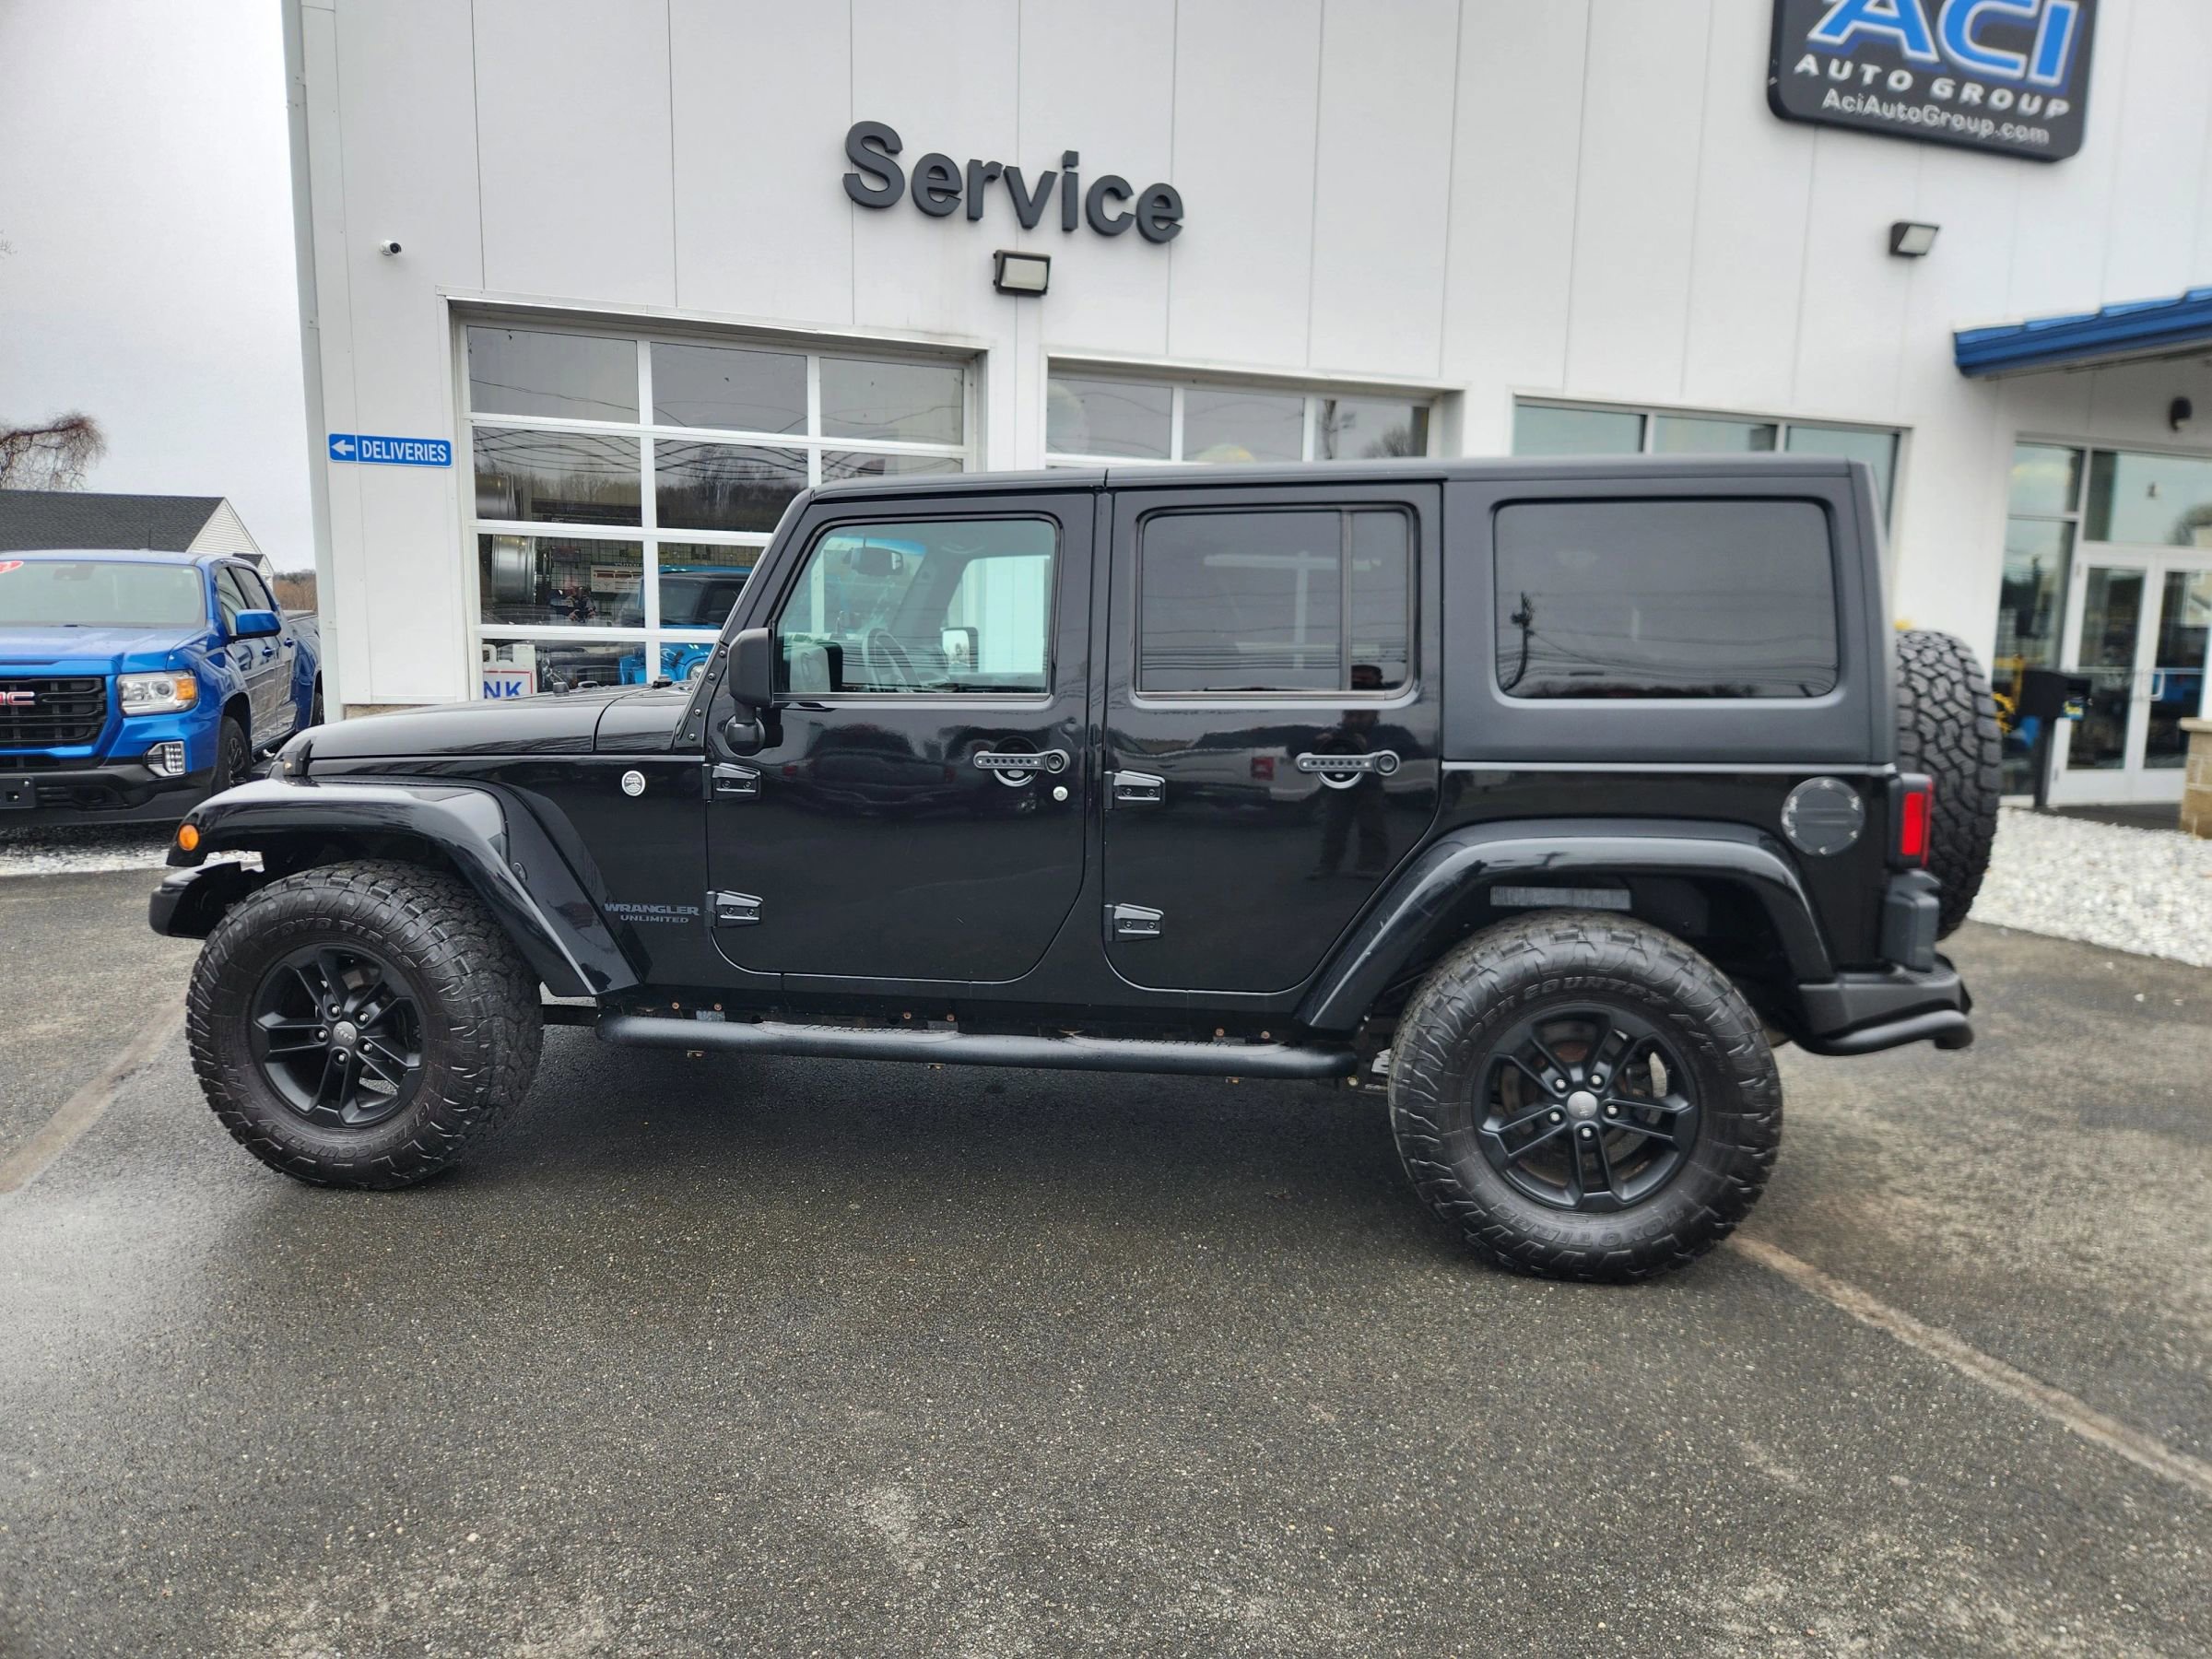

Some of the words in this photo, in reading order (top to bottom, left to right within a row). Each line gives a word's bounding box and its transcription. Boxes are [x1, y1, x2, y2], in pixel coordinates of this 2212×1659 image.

[1794, 53, 1913, 92] AUTO
[1932, 77, 2070, 120] GROUP
[1821, 88, 2050, 146] AciAutoGroup.com
[842, 120, 1184, 244] Service
[361, 440, 447, 463] DELIVERIES
[604, 903, 700, 916] WRANGLER
[620, 915, 688, 924] UNLIMITED
